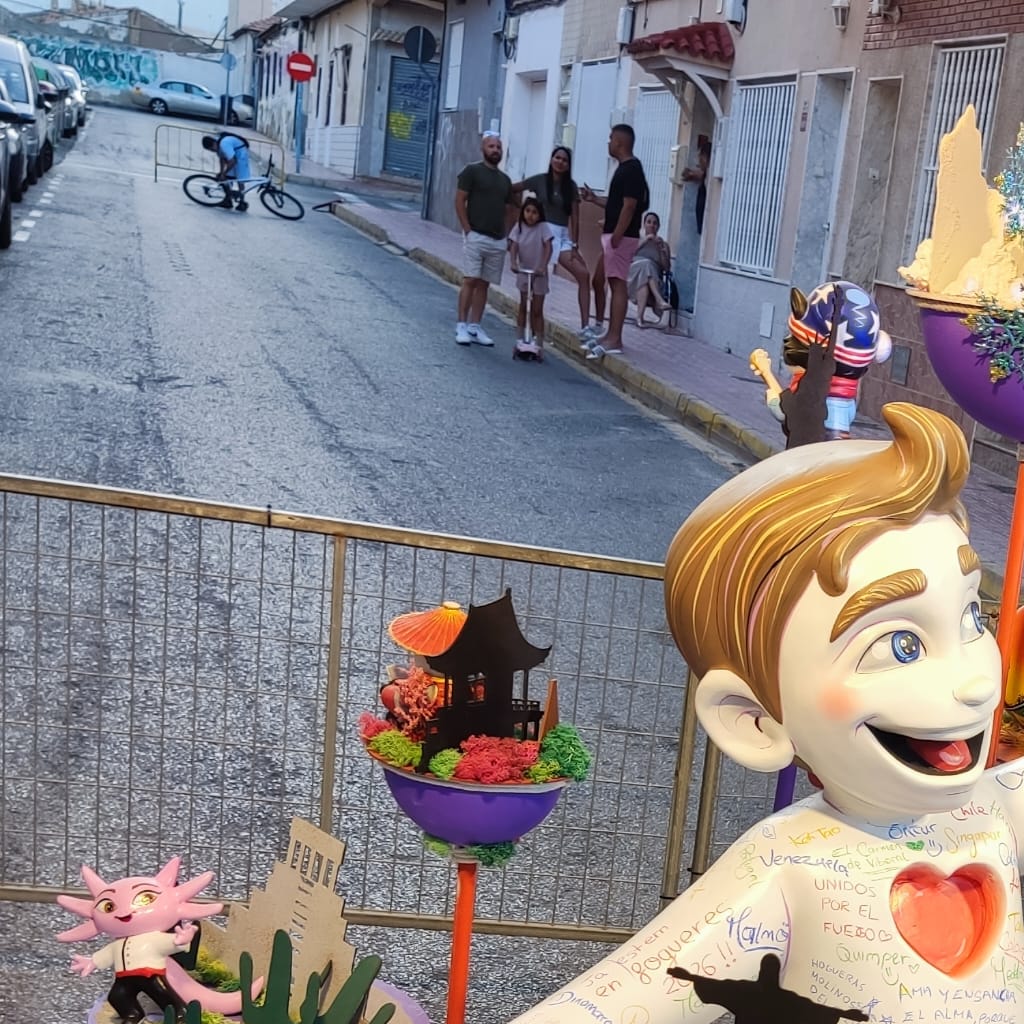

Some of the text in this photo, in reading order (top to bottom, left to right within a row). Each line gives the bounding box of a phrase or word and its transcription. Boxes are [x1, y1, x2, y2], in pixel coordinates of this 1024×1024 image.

[759, 849, 849, 876] Venezuela
[814, 878, 877, 898] UNIDOS
[821, 899, 879, 921] POR EL
